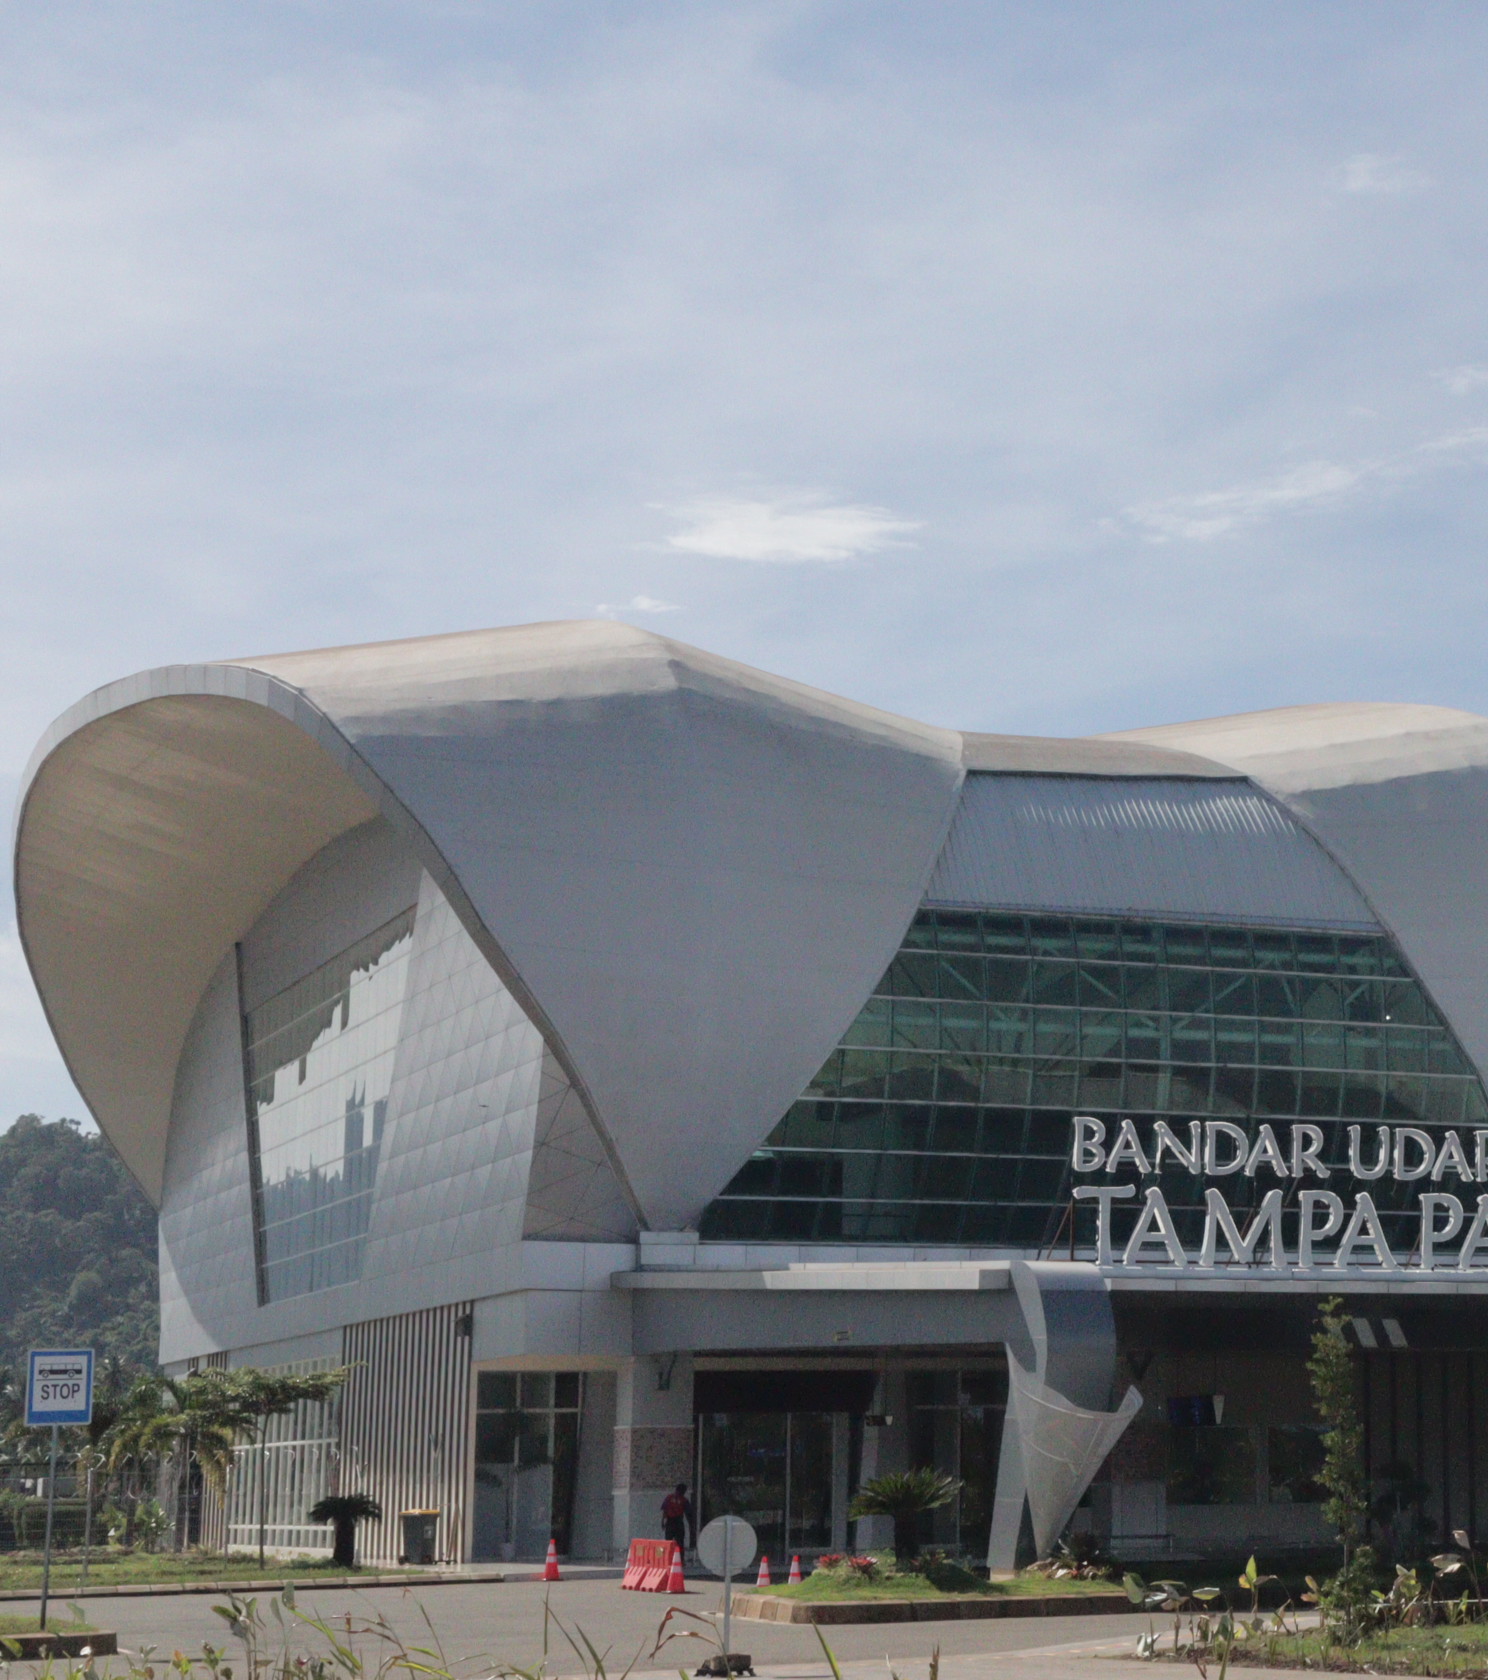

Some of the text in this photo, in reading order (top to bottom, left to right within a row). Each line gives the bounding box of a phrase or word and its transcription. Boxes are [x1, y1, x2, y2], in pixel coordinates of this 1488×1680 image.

[1073, 1116, 1331, 1179] BANDAR
[1073, 1185, 1397, 1269] TAMPA
[41, 1384, 80, 1400] STOP
